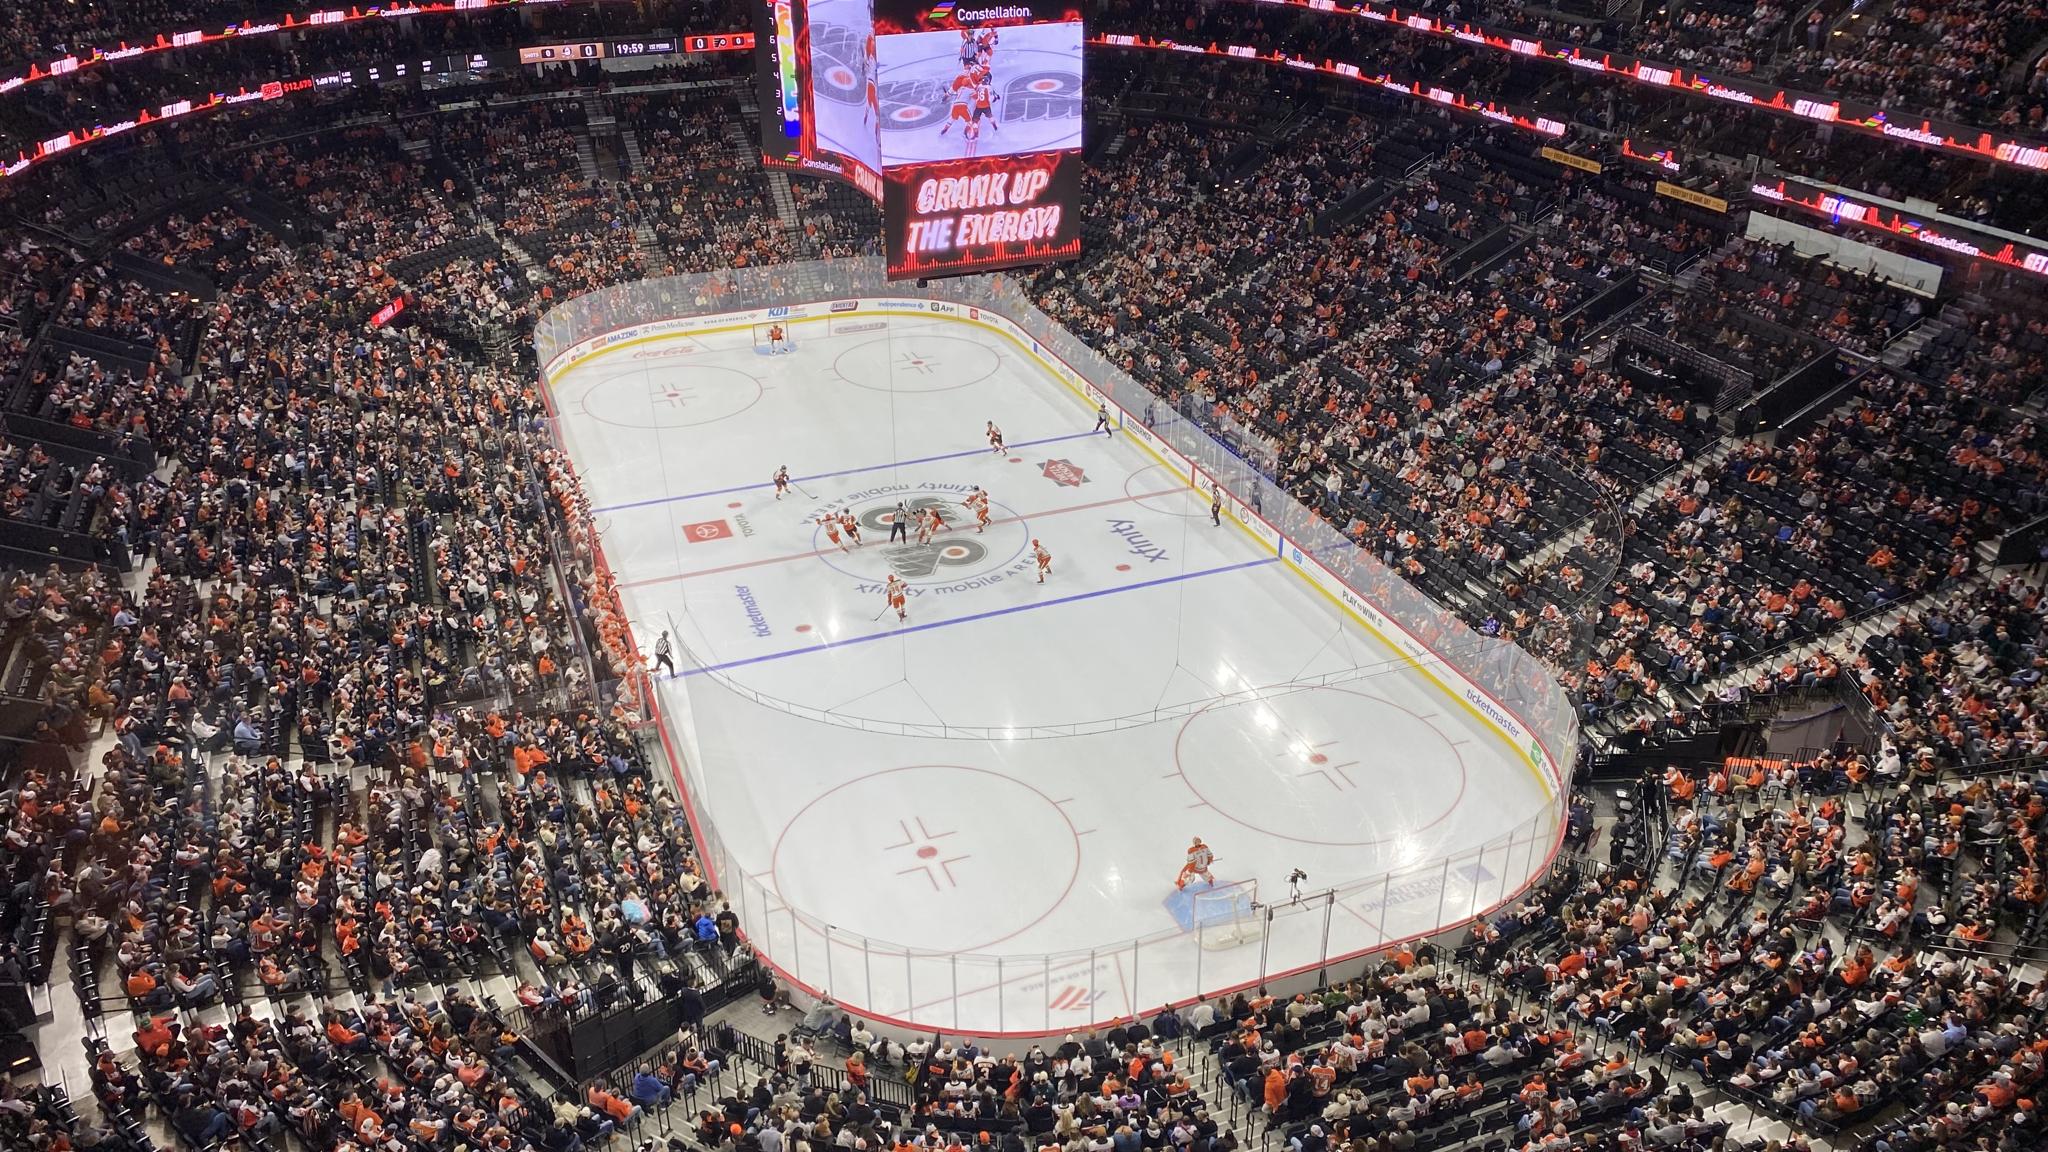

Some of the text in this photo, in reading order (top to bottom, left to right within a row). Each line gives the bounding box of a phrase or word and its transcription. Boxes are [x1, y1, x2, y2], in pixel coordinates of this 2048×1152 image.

[310, 13, 322, 24] GET
[380, 6, 420, 16] Constellation
[958, 5, 1032, 20] Constellation
[769, 17, 774, 25] 7
[238, 24, 278, 35] Constellation
[696, 38, 704, 48] 0
[1106, 34, 1118, 44] GET
[585, 46, 592, 56] 0
[616, 44, 643, 54] 19:59
[1172, 43, 1204, 52] Constellation
[1568, 55, 1605, 70] Constellation
[329, 76, 339, 84] PM
[1638, 66, 1650, 80] GET
[1708, 86, 1753, 103] Constellation
[777, 107, 782, 115] 2
[1794, 100, 1810, 116] GET
[1884, 123, 1942, 146] Constellation
[1996, 143, 2015, 162] GET
[803, 158, 842, 174] Constellation
[916, 169, 1050, 214] CRANK UP
[1820, 197, 1836, 213] GET
[906, 205, 1060, 253] THE ENERGY!
[1920, 230, 1980, 256] Constellation
[980, 313, 999, 324] TOYOTA
[607, 330, 638, 344] AMAZING
[848, 483, 910, 500] mobile
[734, 513, 756, 538] TOYOTA
[1106, 519, 1170, 563] xfinity
[935, 574, 1004, 596] mobile
[1342, 590, 1357, 607] PLAY
[735, 584, 772, 638] ticketmaster
[1466, 689, 1520, 738] ticketmaster
[620, 942, 630, 953] 20
